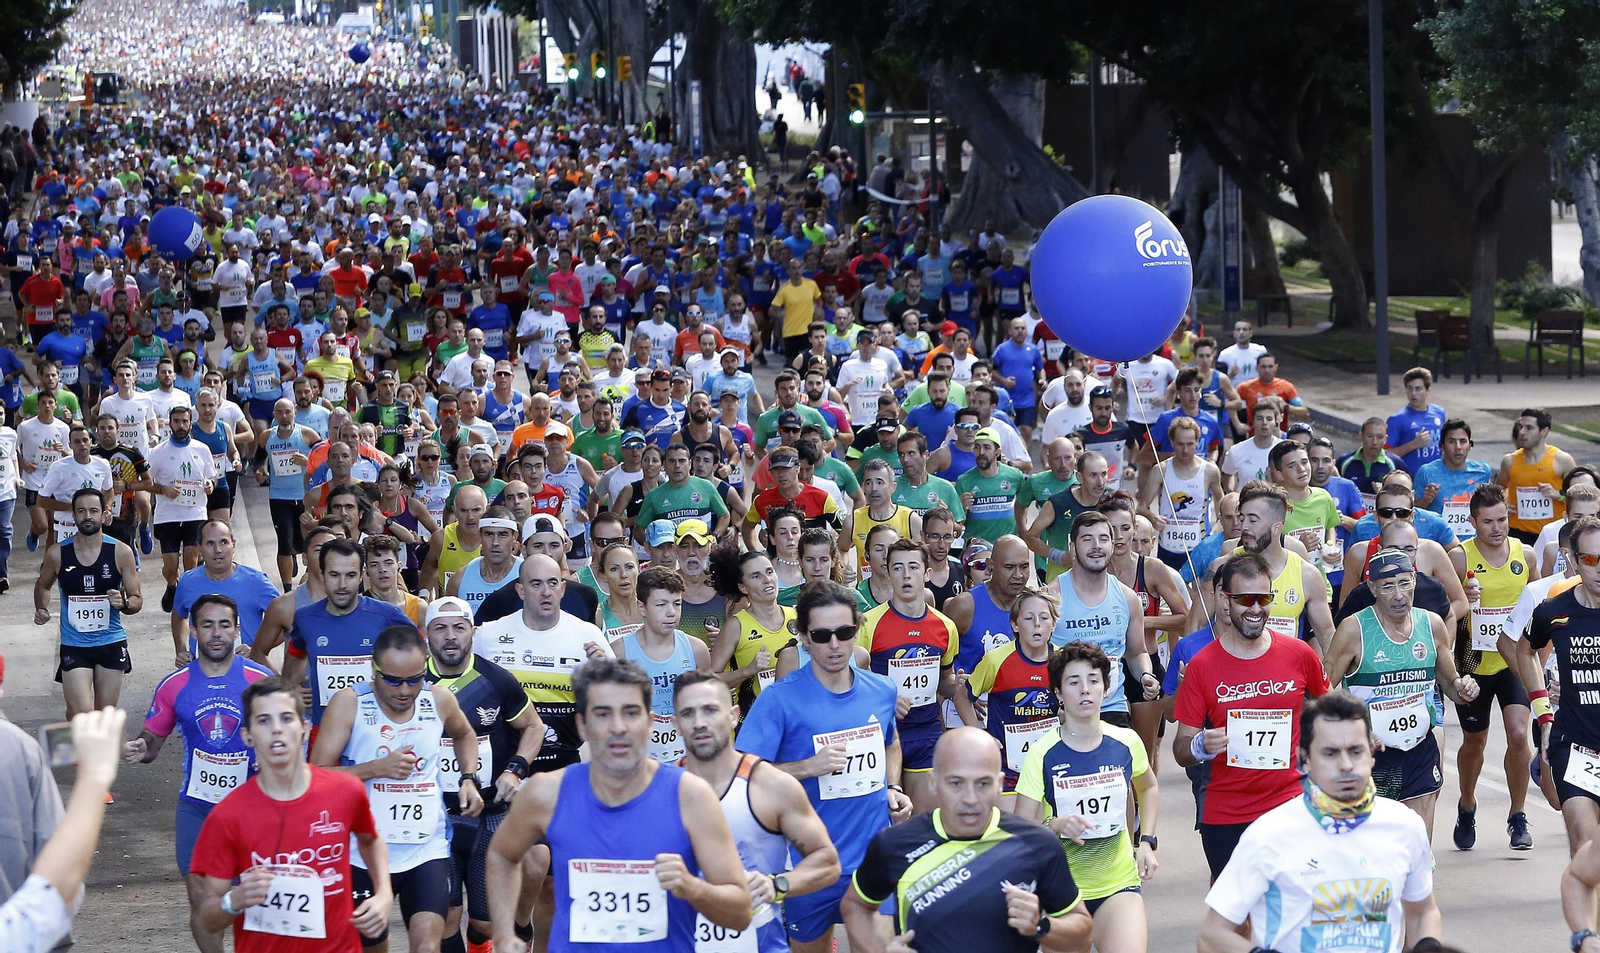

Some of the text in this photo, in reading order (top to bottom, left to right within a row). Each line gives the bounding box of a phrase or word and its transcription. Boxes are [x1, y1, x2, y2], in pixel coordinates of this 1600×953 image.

[1134, 220, 1189, 259] Forus
[181, 488, 197, 497] 383
[976, 495, 1008, 504] ATLETISMO
[1520, 498, 1550, 509] 17010
[667, 509, 699, 520] ATLETISMO
[1166, 530, 1196, 541] 18460
[466, 590, 493, 601] ner
[75, 609, 104, 620] 1916
[1066, 615, 1111, 631] nerja
[1570, 636, 1600, 647] WOR
[1570, 647, 1600, 655] MARAT
[532, 655, 554, 663] prepol
[902, 674, 929, 689] 419
[1379, 671, 1427, 684] ATLETISMO
[553, 683, 573, 692] MÁL
[1371, 703, 1382, 711] 41
[1230, 711, 1241, 719] 41
[1006, 725, 1016, 733] 41
[1388, 714, 1418, 734] 498
[816, 737, 829, 745] 41
[1245, 730, 1278, 747] 177
[200, 770, 237, 789] 9963
[1056, 780, 1069, 789] 41
[1076, 795, 1112, 816] 197
[389, 804, 423, 821] 178
[904, 847, 977, 903] BUITRERAS
[912, 867, 973, 914] RUNNING
[588, 891, 650, 913] 3315
